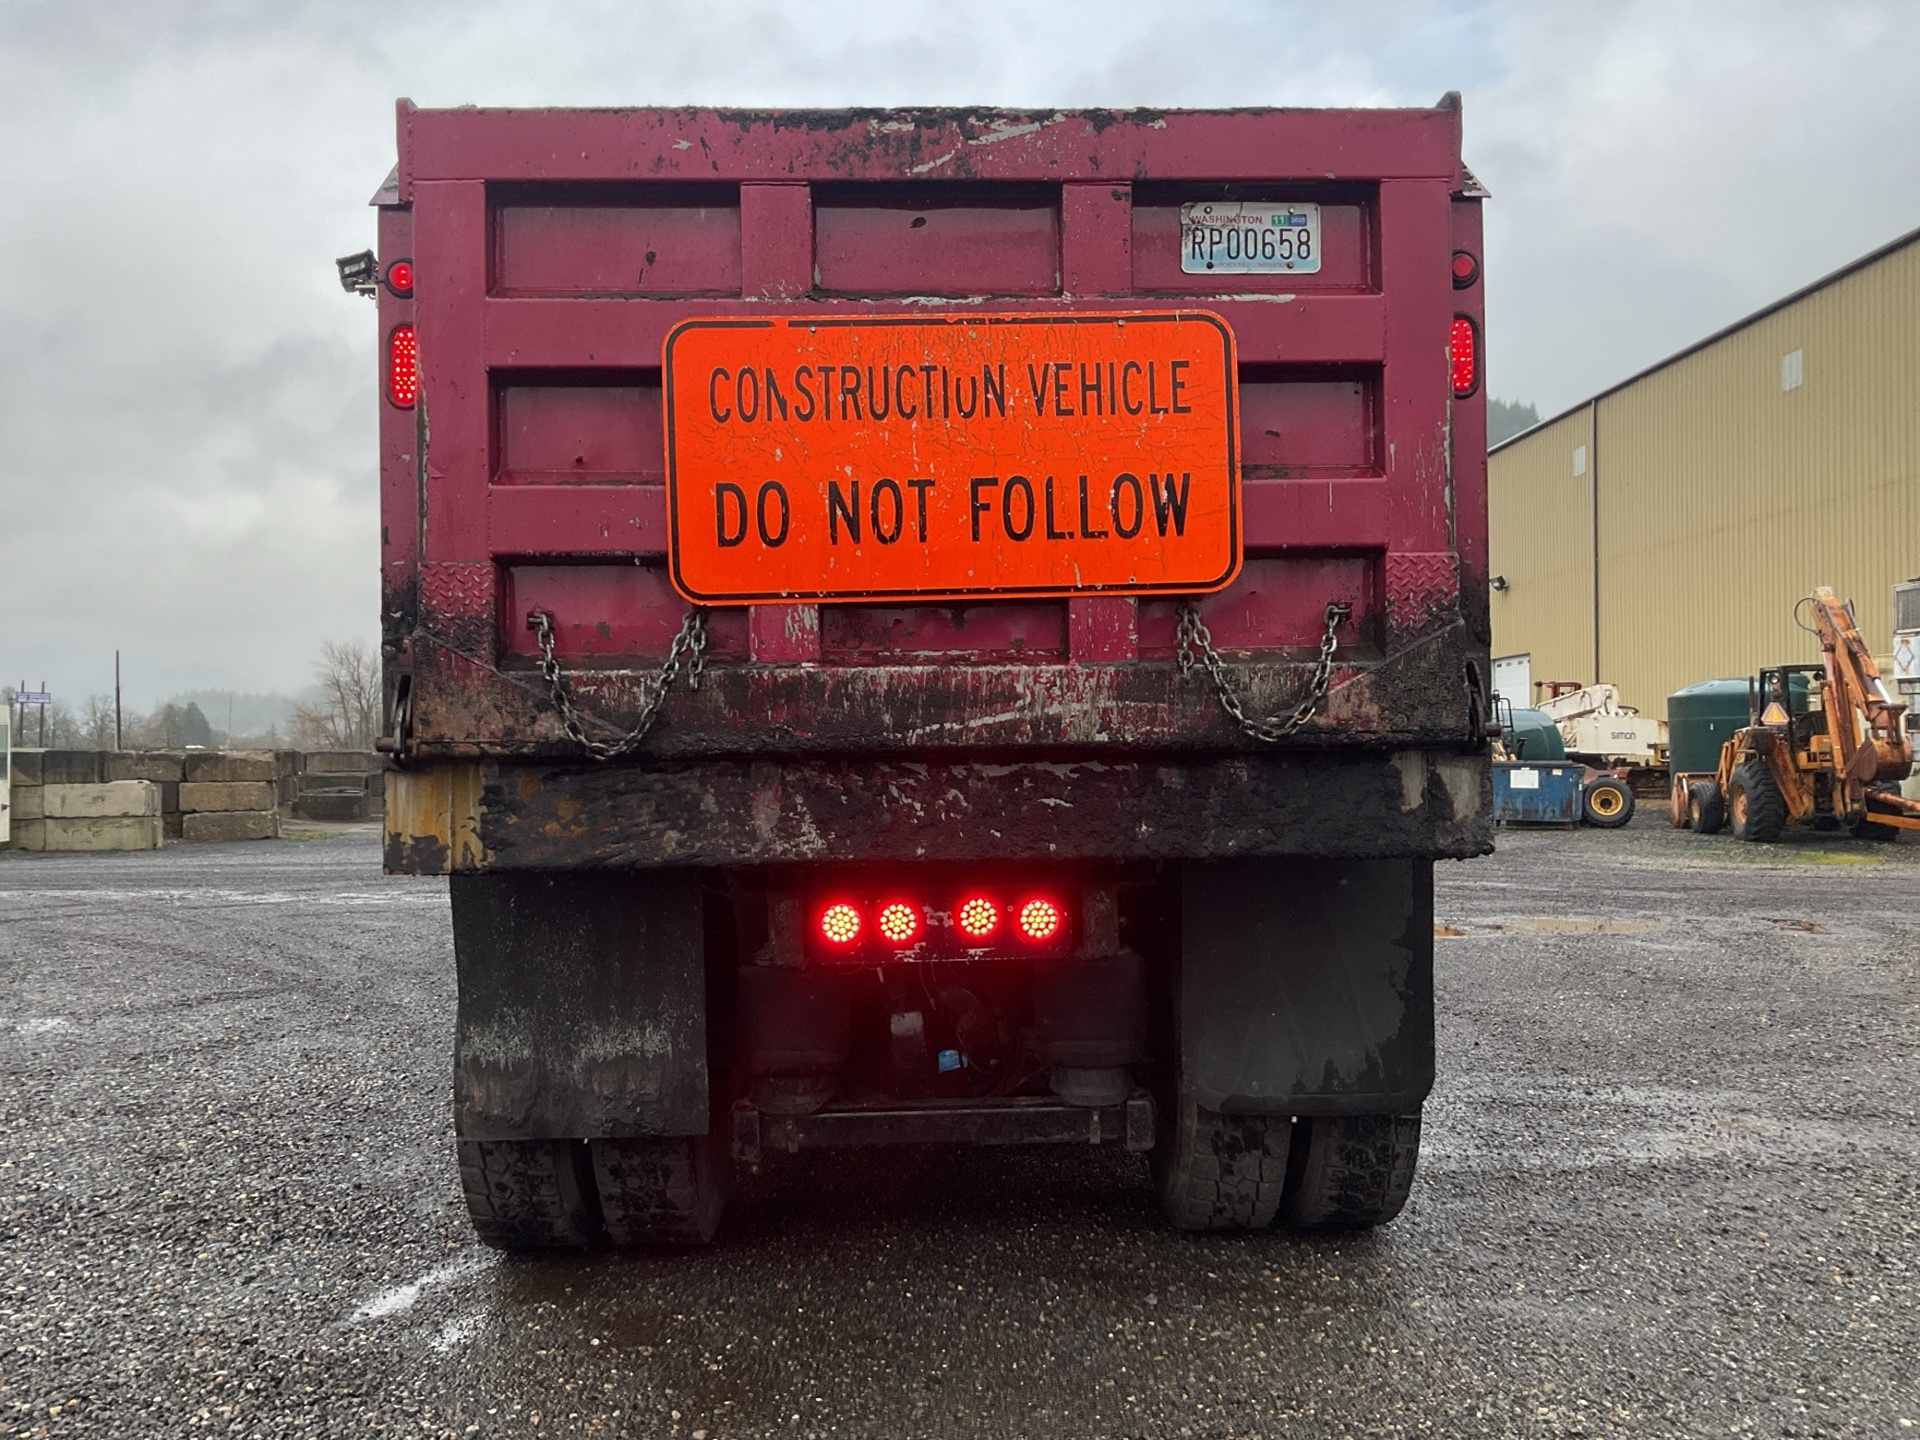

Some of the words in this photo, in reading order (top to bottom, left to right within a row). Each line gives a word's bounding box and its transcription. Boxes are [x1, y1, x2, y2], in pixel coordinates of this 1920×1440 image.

[1190, 214, 1263, 224] WASHINGTON
[1274, 215, 1284, 224] 11
[708, 365, 1006, 424] CONSTRUCTION
[1028, 360, 1192, 417] VEHICLE
[717, 480, 790, 549] DO
[828, 478, 936, 548] NOT
[970, 472, 1193, 544] FOLLOW
